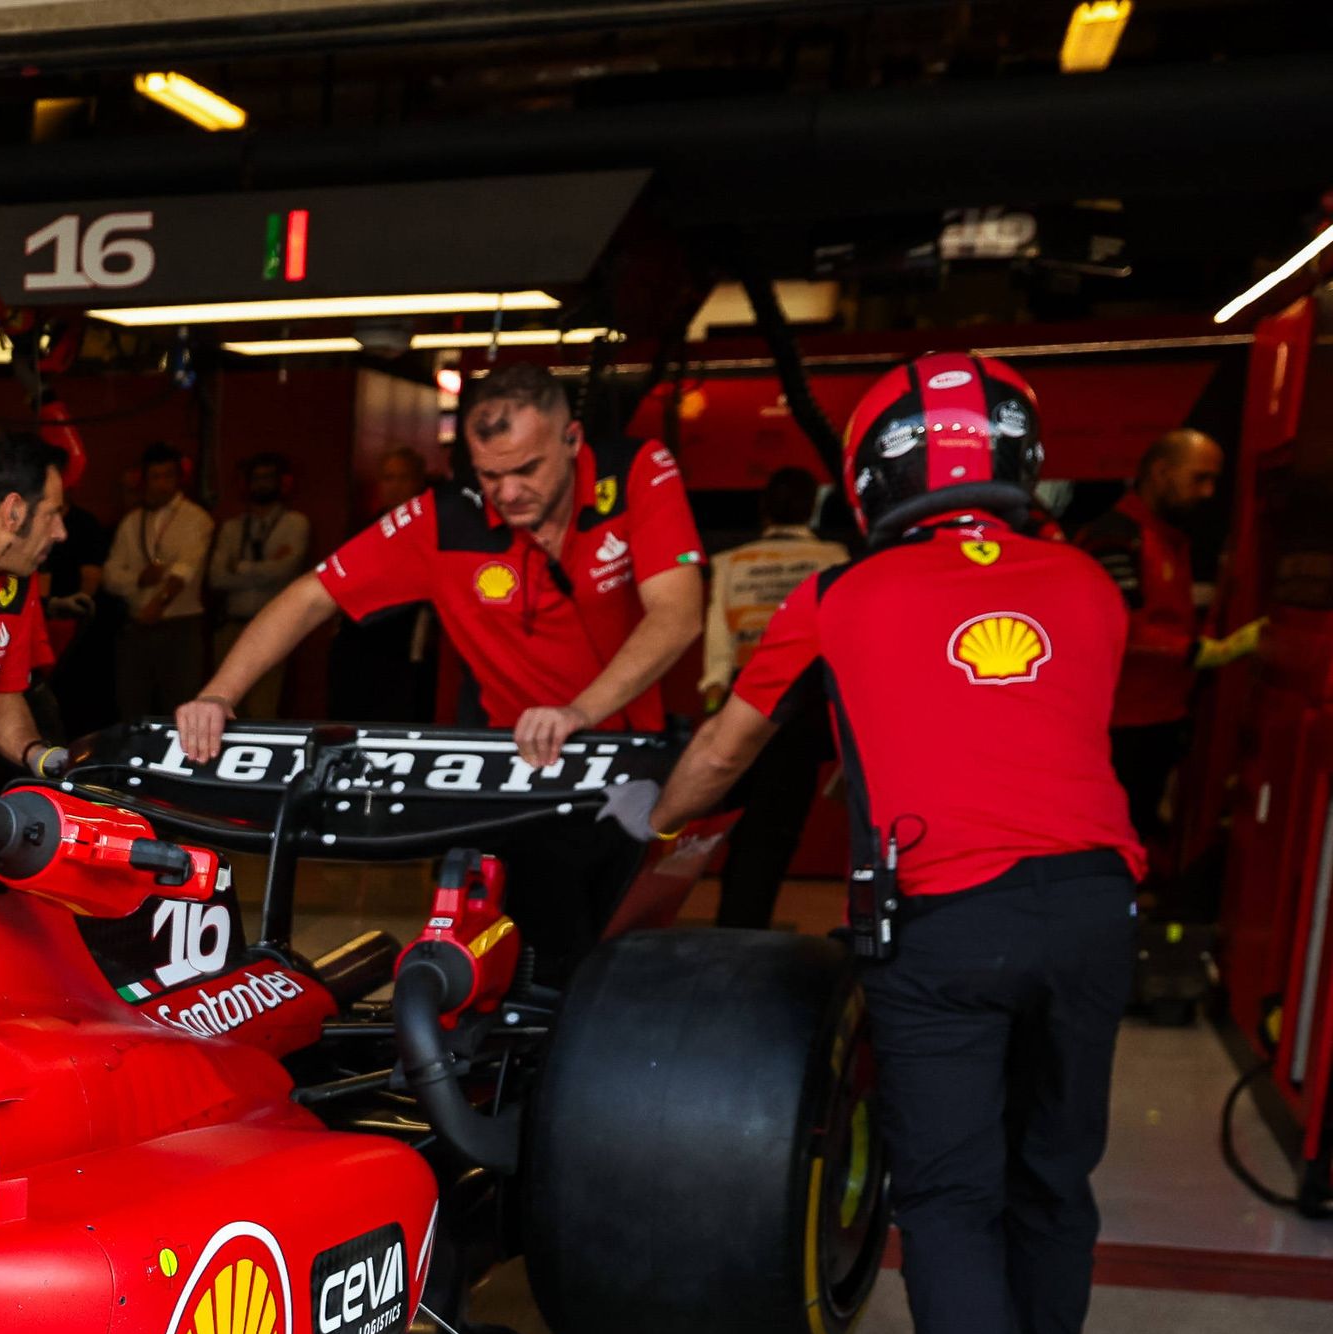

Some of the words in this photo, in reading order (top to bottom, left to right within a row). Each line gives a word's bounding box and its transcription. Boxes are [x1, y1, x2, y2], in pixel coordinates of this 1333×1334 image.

[24, 211, 155, 291] 16
[151, 899, 231, 988] 16
[157, 969, 305, 1039] Santander
